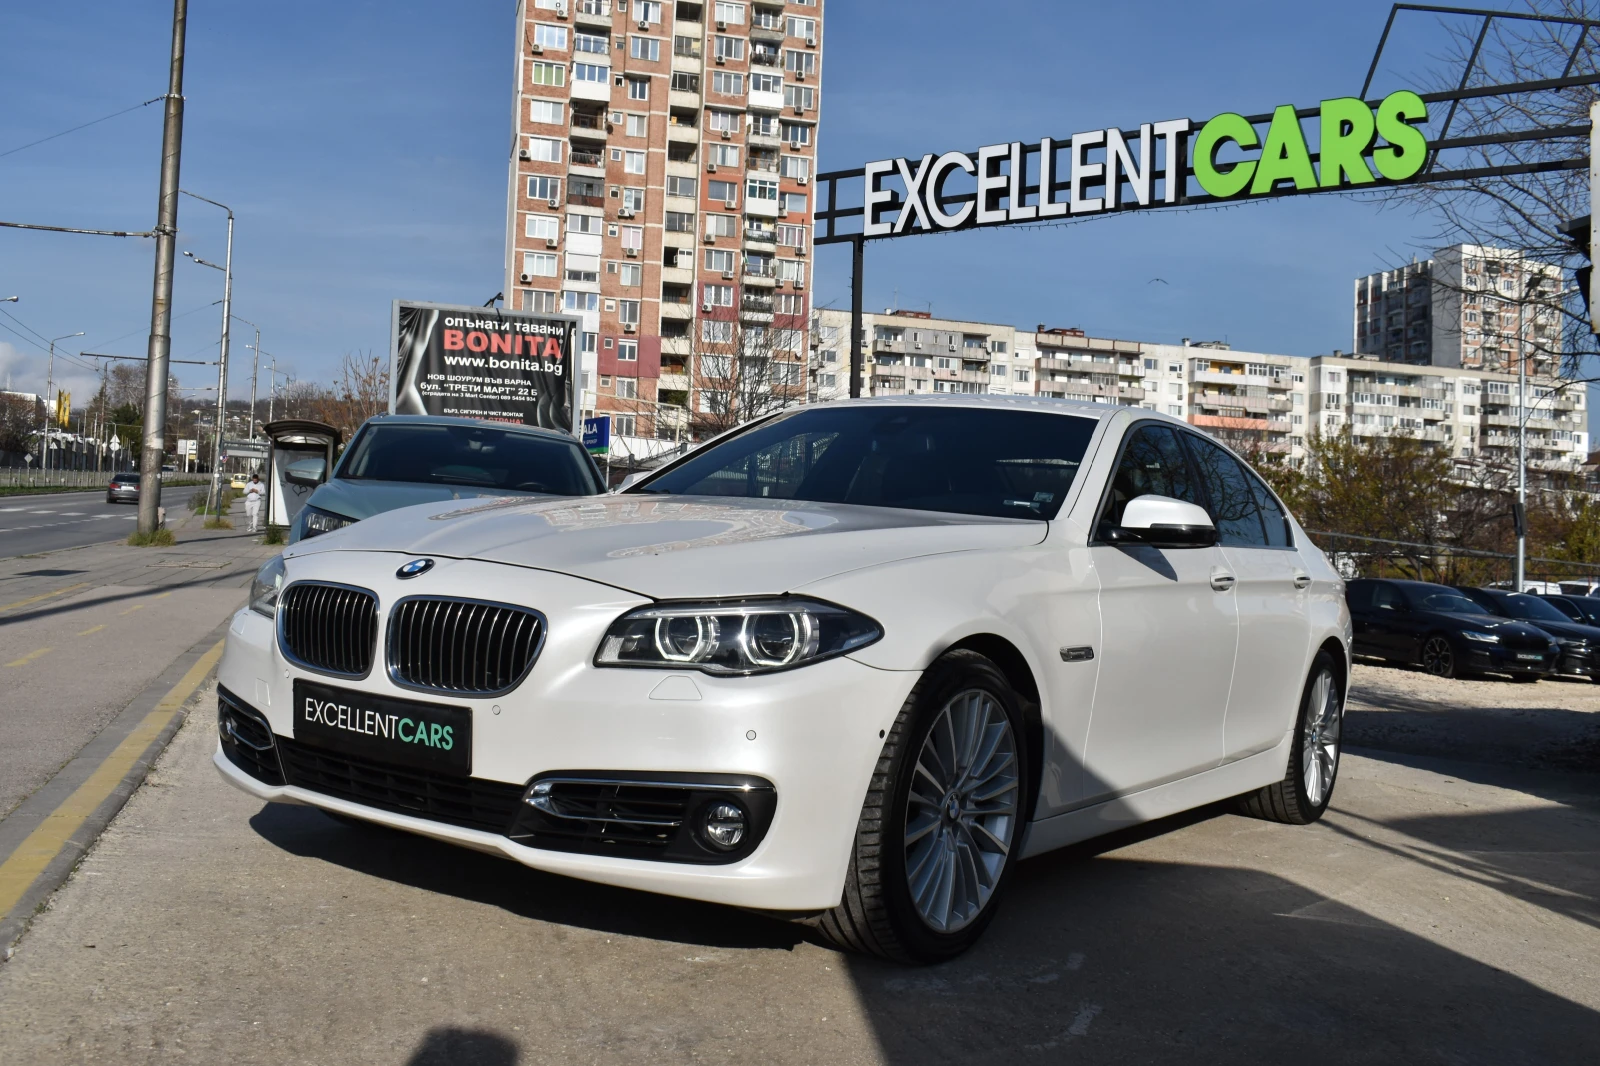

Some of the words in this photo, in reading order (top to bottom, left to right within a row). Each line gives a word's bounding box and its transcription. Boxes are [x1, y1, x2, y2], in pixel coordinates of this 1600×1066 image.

[444, 317, 510, 331] опънати
[514, 322, 564, 336] тавани
[443, 329, 563, 359] BONITA
[444, 355, 563, 376] www.bonita.bg
[420, 382, 441, 391] бул.
[517, 388, 529, 396] 22
[530, 389, 538, 397] Б
[427, 373, 446, 381] НОВ
[447, 374, 483, 383] ШОУРУМ
[484, 377, 503, 385] ВЪВ
[504, 378, 532, 387] ВАРНА
